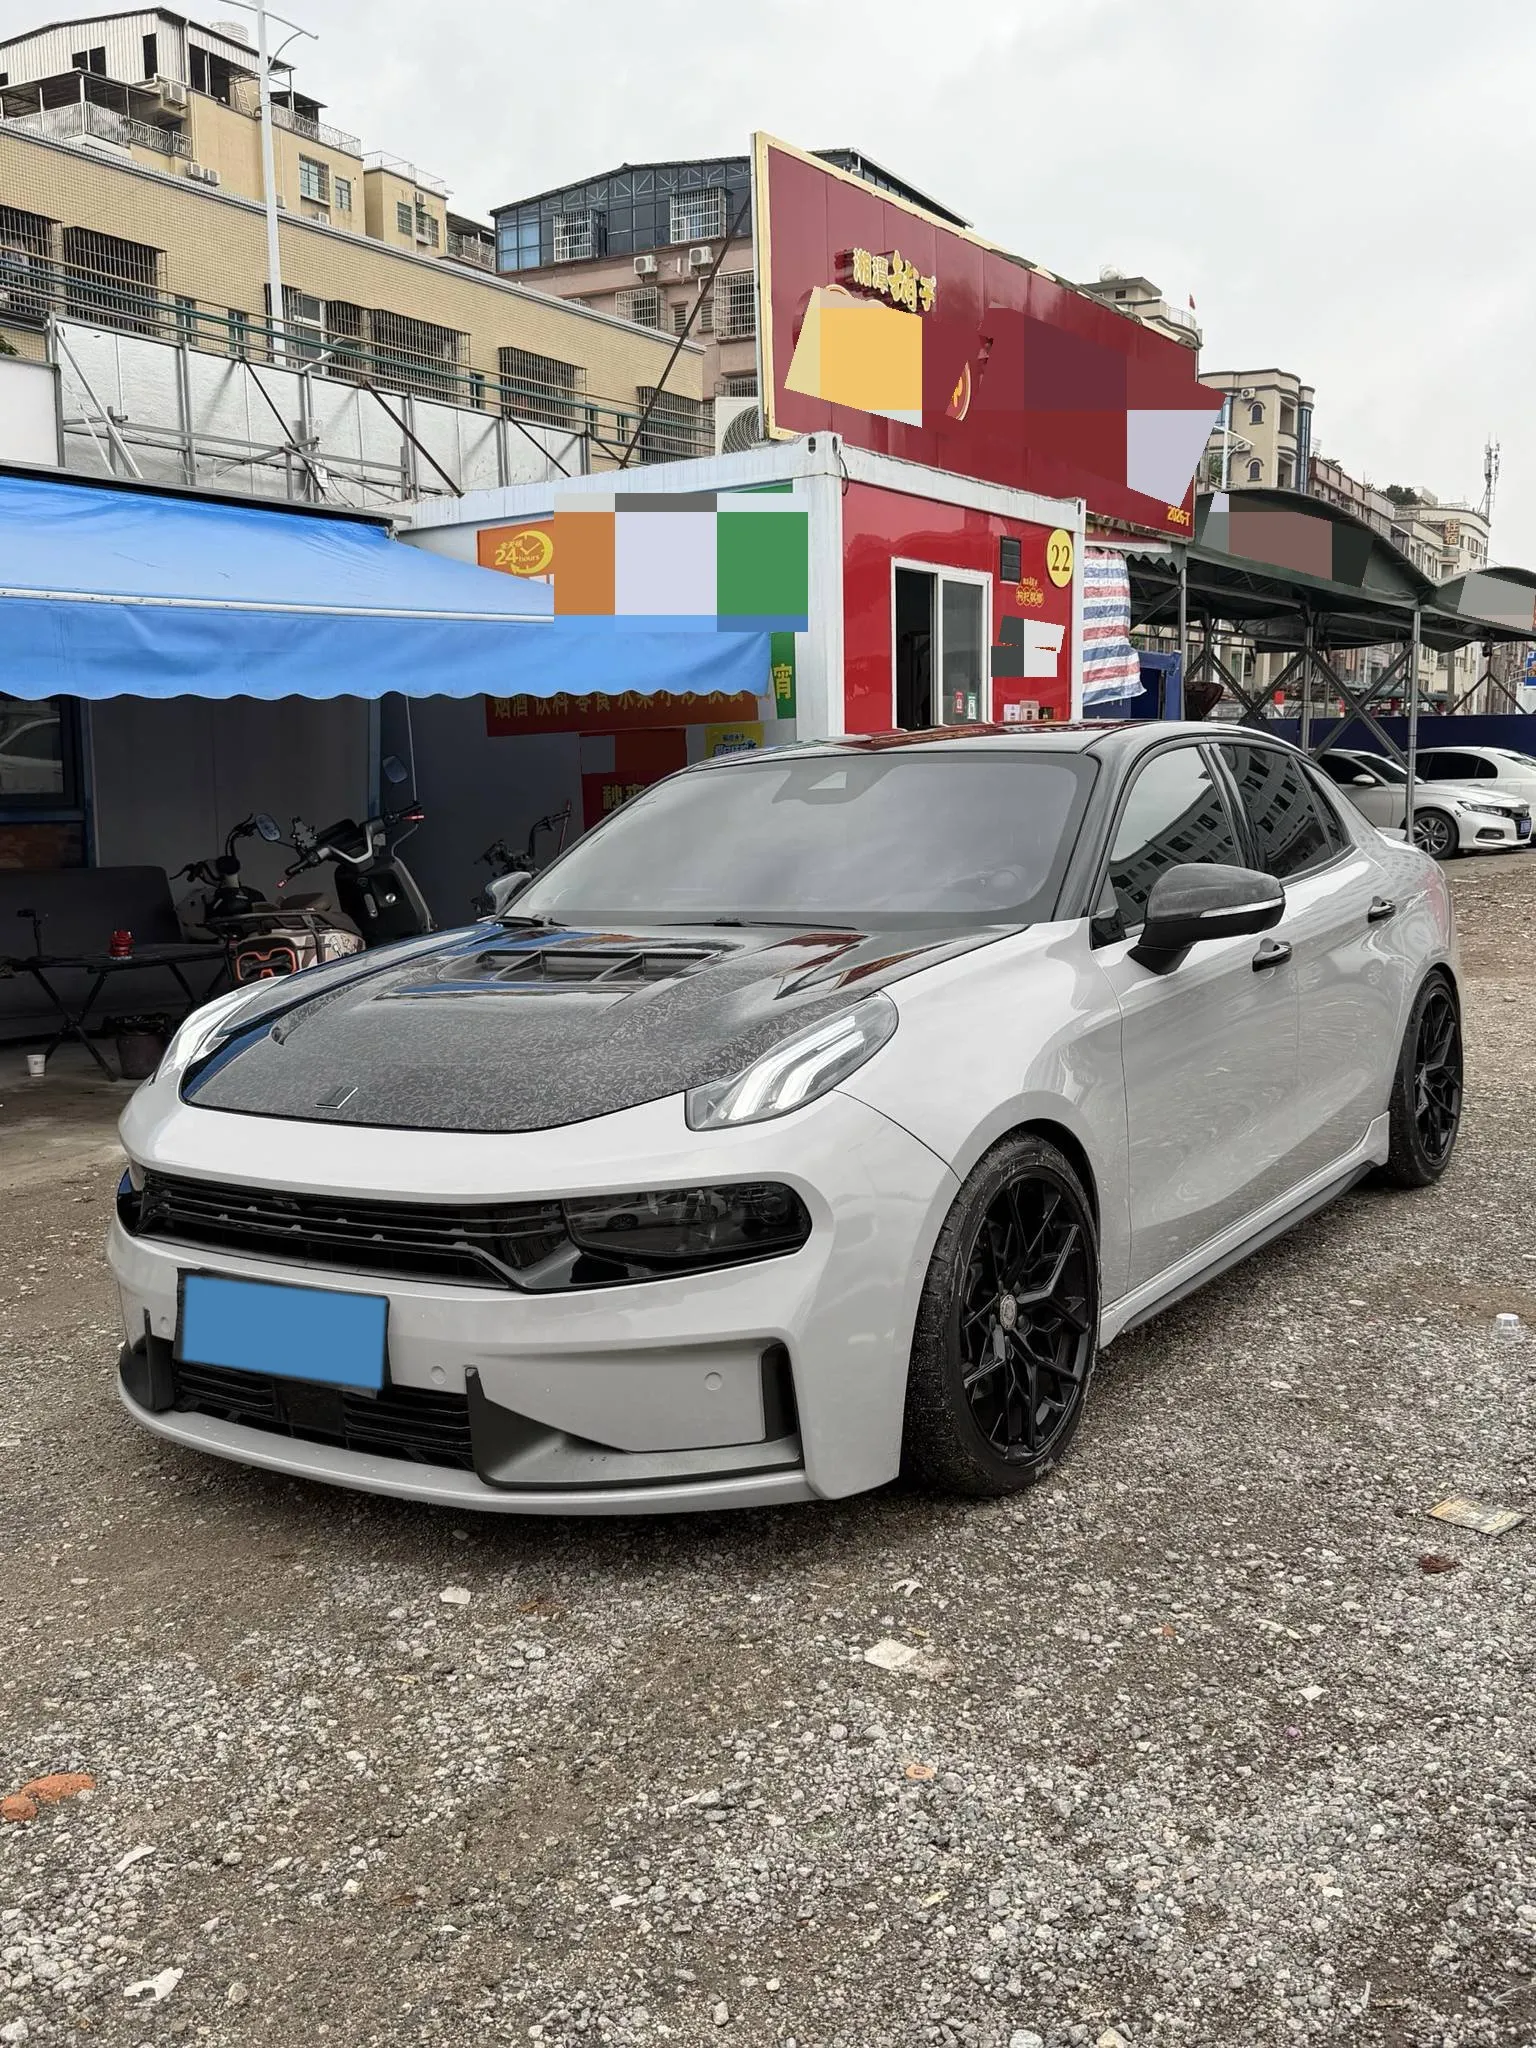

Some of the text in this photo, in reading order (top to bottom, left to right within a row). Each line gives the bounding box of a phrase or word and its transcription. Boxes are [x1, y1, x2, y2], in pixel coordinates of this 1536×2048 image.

[495, 548, 518, 565] 24
[1051, 544, 1070, 572] 22
[774, 663, 792, 699] 宵
